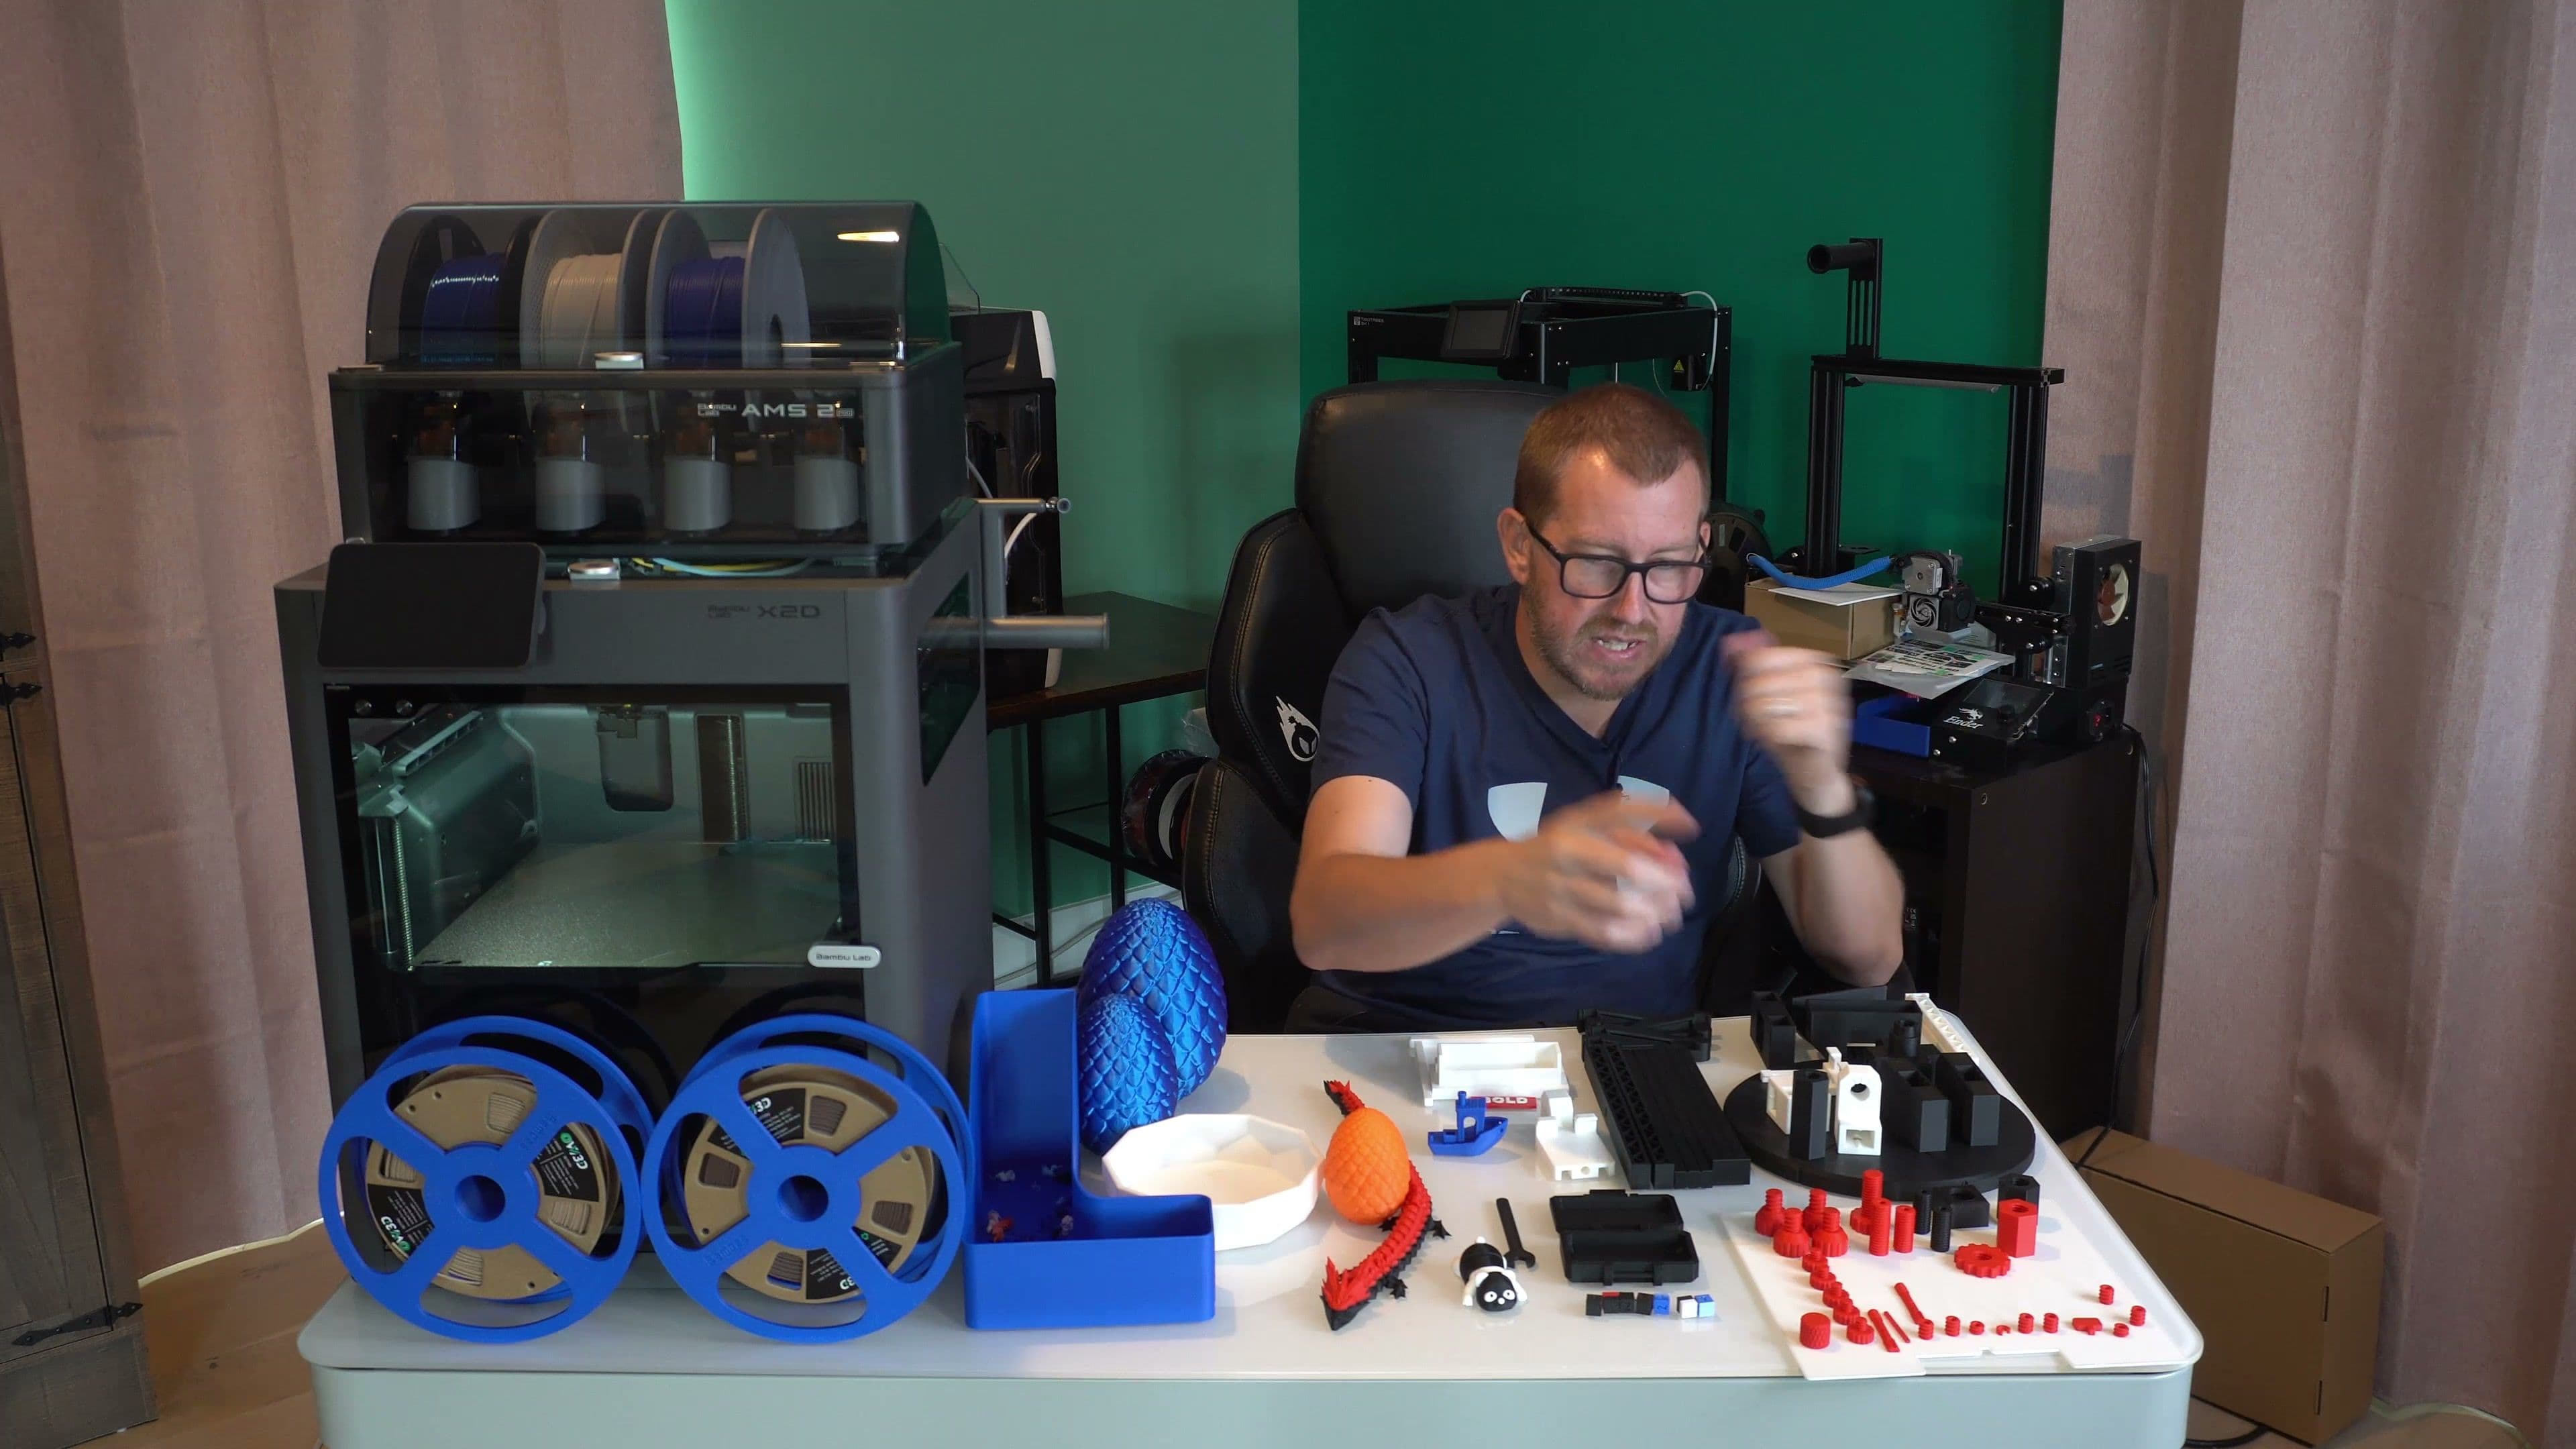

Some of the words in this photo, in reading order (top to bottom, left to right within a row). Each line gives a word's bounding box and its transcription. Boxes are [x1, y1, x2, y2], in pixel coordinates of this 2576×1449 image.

[741, 403, 807, 417] AMS
[816, 403, 835, 417] 2
[757, 605, 820, 619] X2D
[1943, 716, 1984, 729] Ender
